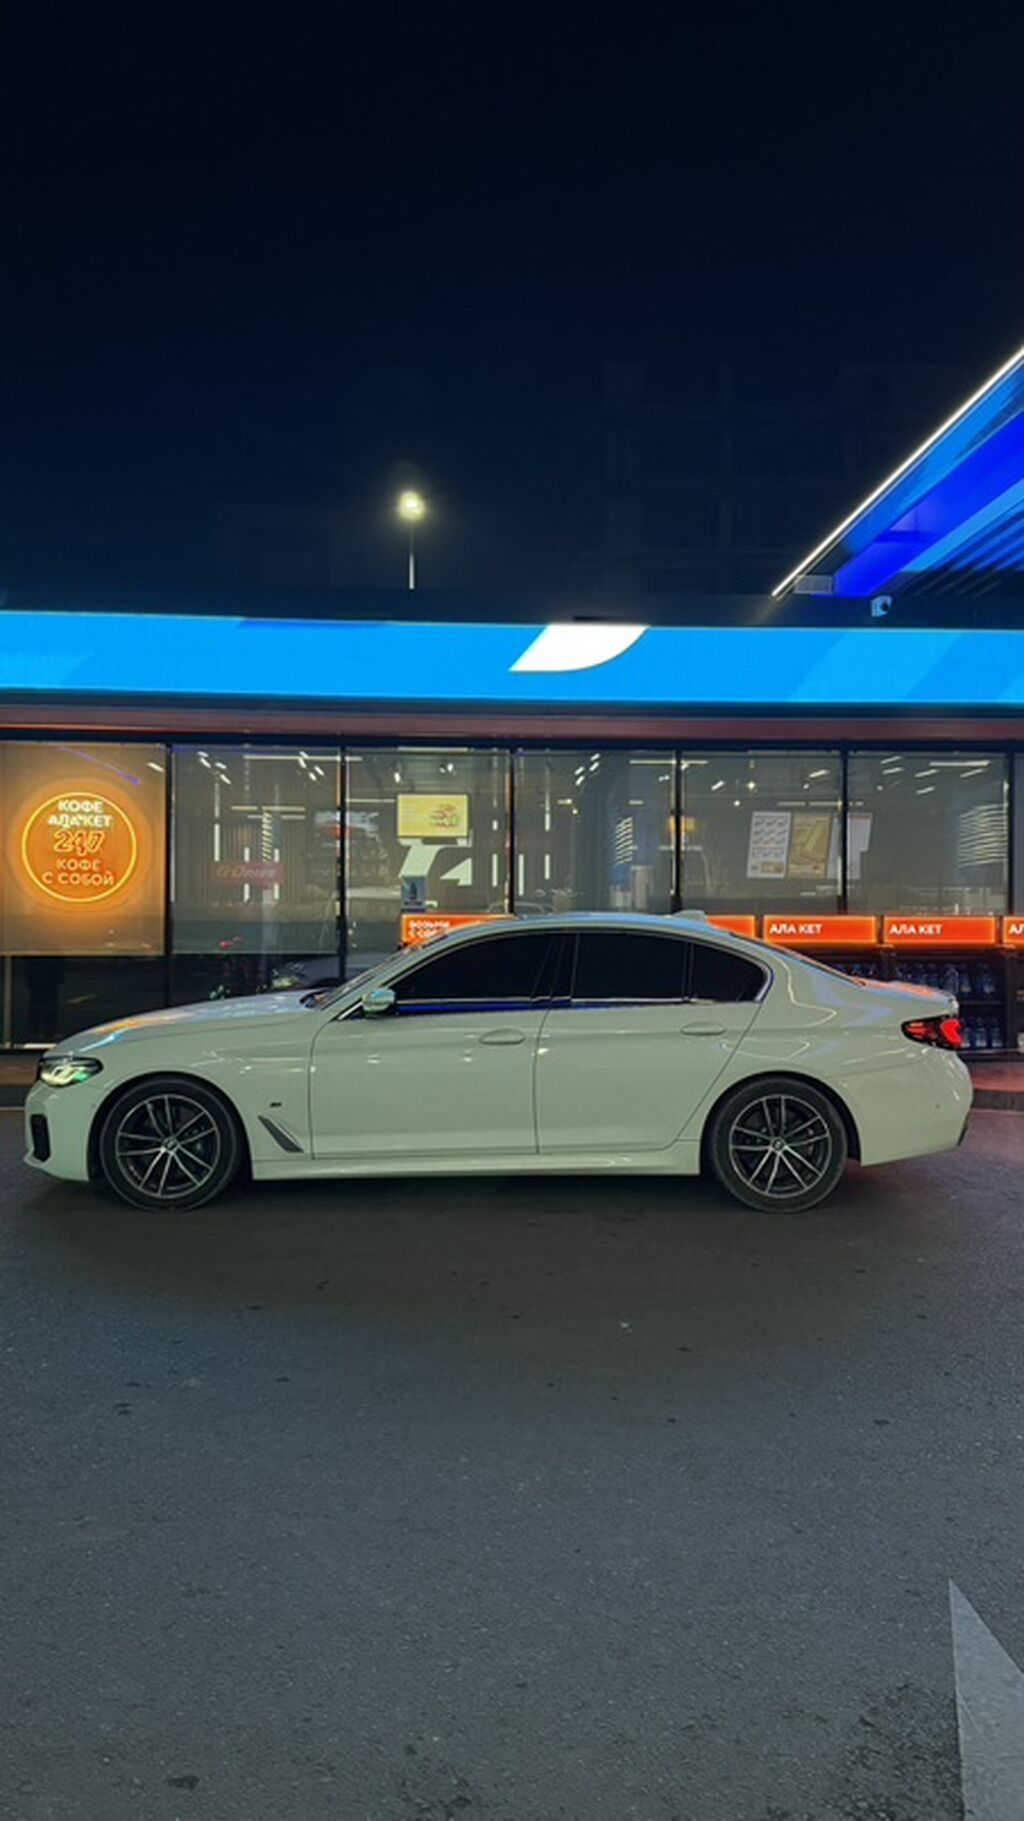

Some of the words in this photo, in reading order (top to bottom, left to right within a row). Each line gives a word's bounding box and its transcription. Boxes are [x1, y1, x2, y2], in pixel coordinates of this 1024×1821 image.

[58, 800, 104, 813] КОФЕ
[57, 859, 101, 871] КОФЕ
[43, 871, 54, 884] С
[58, 871, 114, 886] СОБОЙ
[770, 923, 796, 934] АЛА
[799, 923, 823, 934] КЕТ
[889, 923, 916, 935] АЛА
[918, 924, 942, 935] КЕТ
